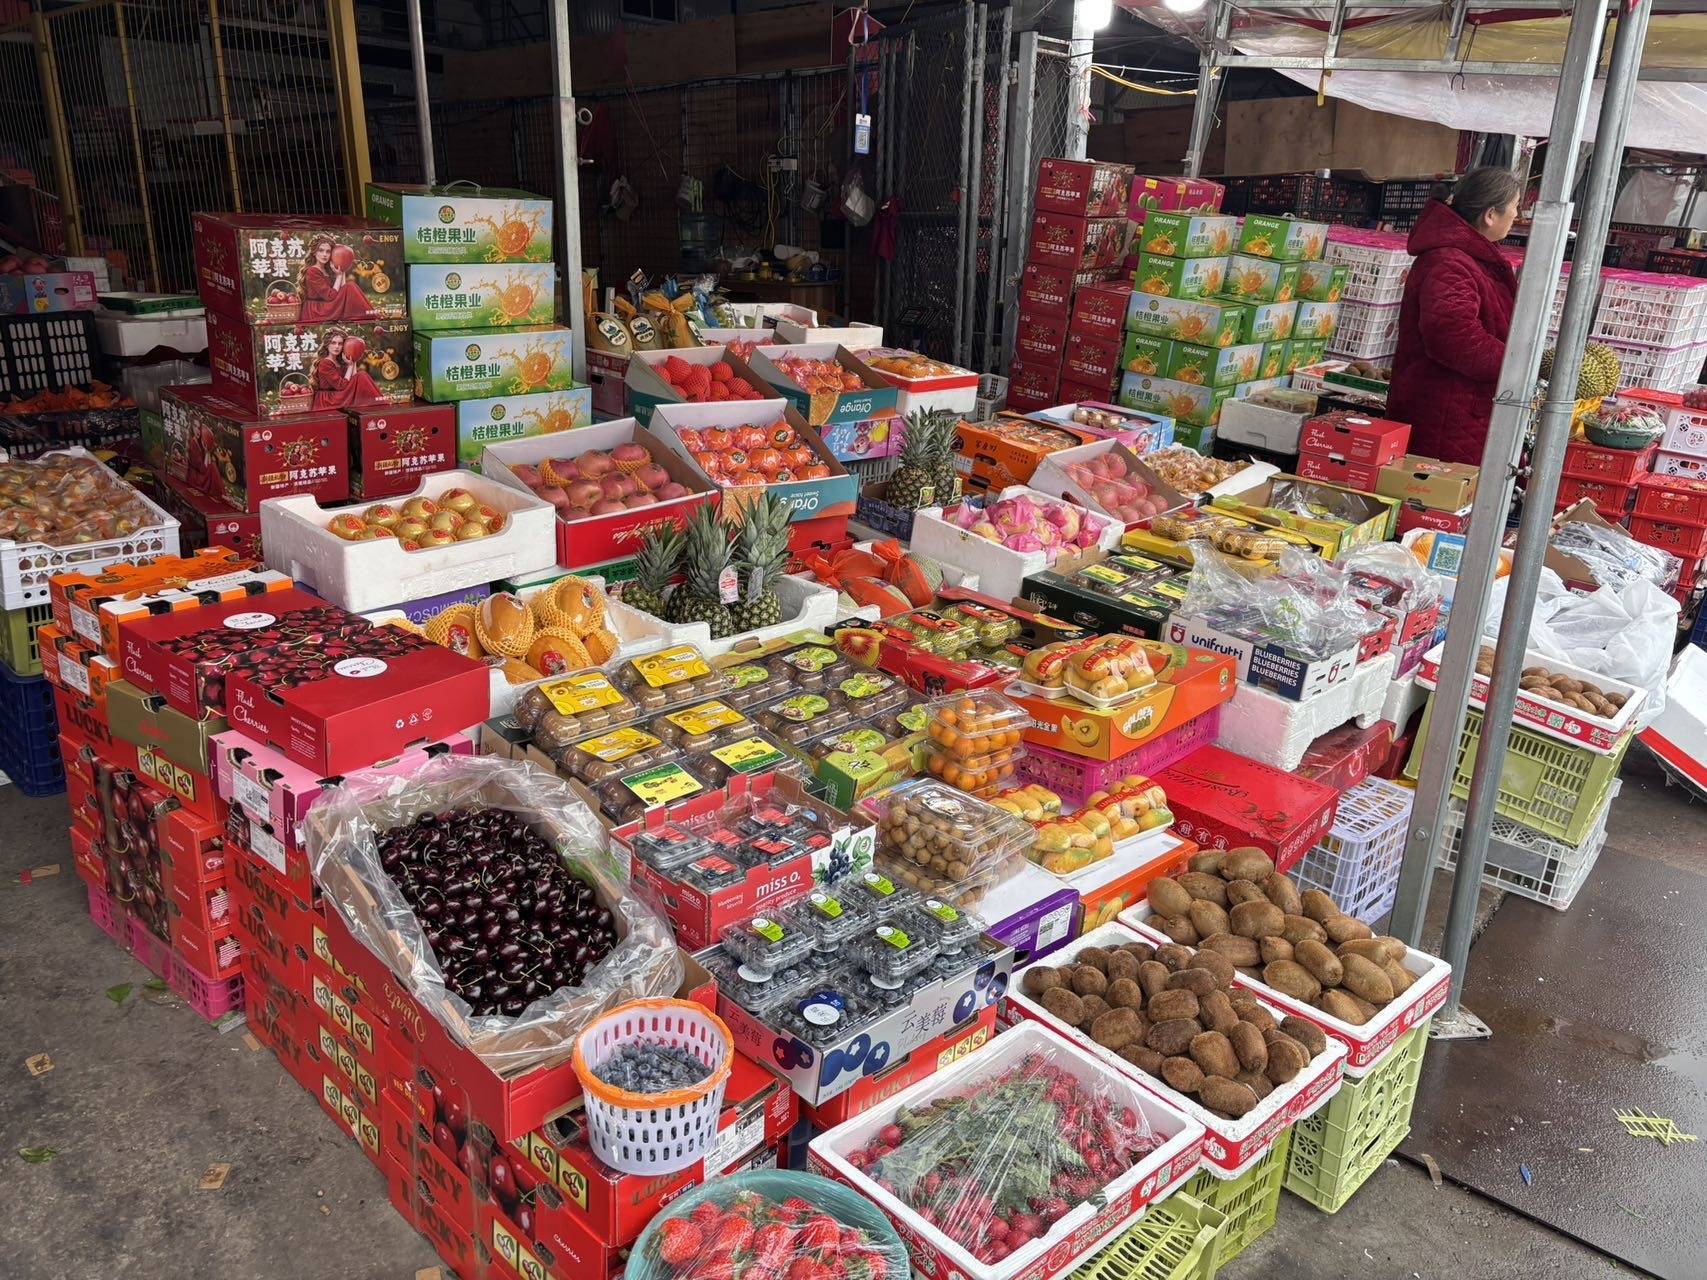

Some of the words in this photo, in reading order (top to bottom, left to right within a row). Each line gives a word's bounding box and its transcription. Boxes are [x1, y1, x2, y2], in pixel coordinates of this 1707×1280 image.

[371, 193, 394, 209] ORANGE
[1055, 188, 1081, 198] 阿克苏苹果
[1153, 217, 1180, 226] ORANGE
[1253, 219, 1280, 229] ORANGE
[379, 234, 400, 243] ENGY
[417, 226, 477, 244] 桔橙果业
[1191, 234, 1210, 246] 桔橙果业
[250, 237, 306, 258] 阿克苏
[1050, 243, 1075, 253] 阿克苏苹果
[1287, 238, 1305, 250] 桔橙果业
[251, 258, 291, 278] 苹果
[1148, 257, 1175, 268] ORANGE
[1184, 276, 1202, 288] 桔橙果业
[424, 293, 483, 310] 桔橙果业
[1040, 292, 1063, 303] 阿克苏苹果
[1091, 314, 1116, 325] 阿克苏苹果
[1135, 310, 1169, 325] 桔橙果业
[389, 324, 409, 333] ENGY
[1257, 320, 1273, 332] 桔橙果业
[263, 333, 319, 353] 阿克苏
[1033, 341, 1057, 352] 阿克苏苹果
[1135, 338, 1162, 348] ORANGE
[1182, 346, 1209, 357] ORANGE
[266, 353, 304, 372] 苹果
[1083, 362, 1107, 374] 阿克苏苹果
[1220, 363, 1238, 375] 桔橙果业
[446, 363, 501, 382] 桔橙果业
[1026, 389, 1048, 399] 阿克苏苹果
[1128, 388, 1161, 404] 桔橙果业
[161, 399, 188, 426] 阿克苏
[839, 402, 871, 413] Orange
[163, 419, 183, 442] 苹果
[472, 421, 525, 441] 桔橙果业
[1175, 425, 1192, 434] ANGE
[1306, 437, 1334, 449] Cherries
[401, 452, 446, 468] 阿克苏苹果
[289, 465, 337, 481] 阿克苏苹果
[1301, 469, 1329, 481] Cherries
[1421, 515, 1451, 529] Cherries
[1191, 633, 1244, 660] unifrutti
[1252, 656, 1300, 678] BLUEBERRIES
[1254, 648, 1301, 670] BLUEBERRIES
[125, 656, 154, 682] Cherries
[1251, 664, 1297, 687] BLUEBERRIES
[64, 701, 113, 746] LUCKY
[233, 705, 269, 734] Cherries
[233, 856, 288, 919] LUCKY
[681, 888, 695, 901] miss
[756, 875, 787, 898] miss
[775, 888, 797, 905] produce
[238, 904, 288, 967] LUCKY
[901, 1002, 948, 1034] 云美莓
[253, 999, 300, 1064] LUCKY
[728, 1009, 763, 1048] 云美莓
[553, 1233, 583, 1263] Cherries
